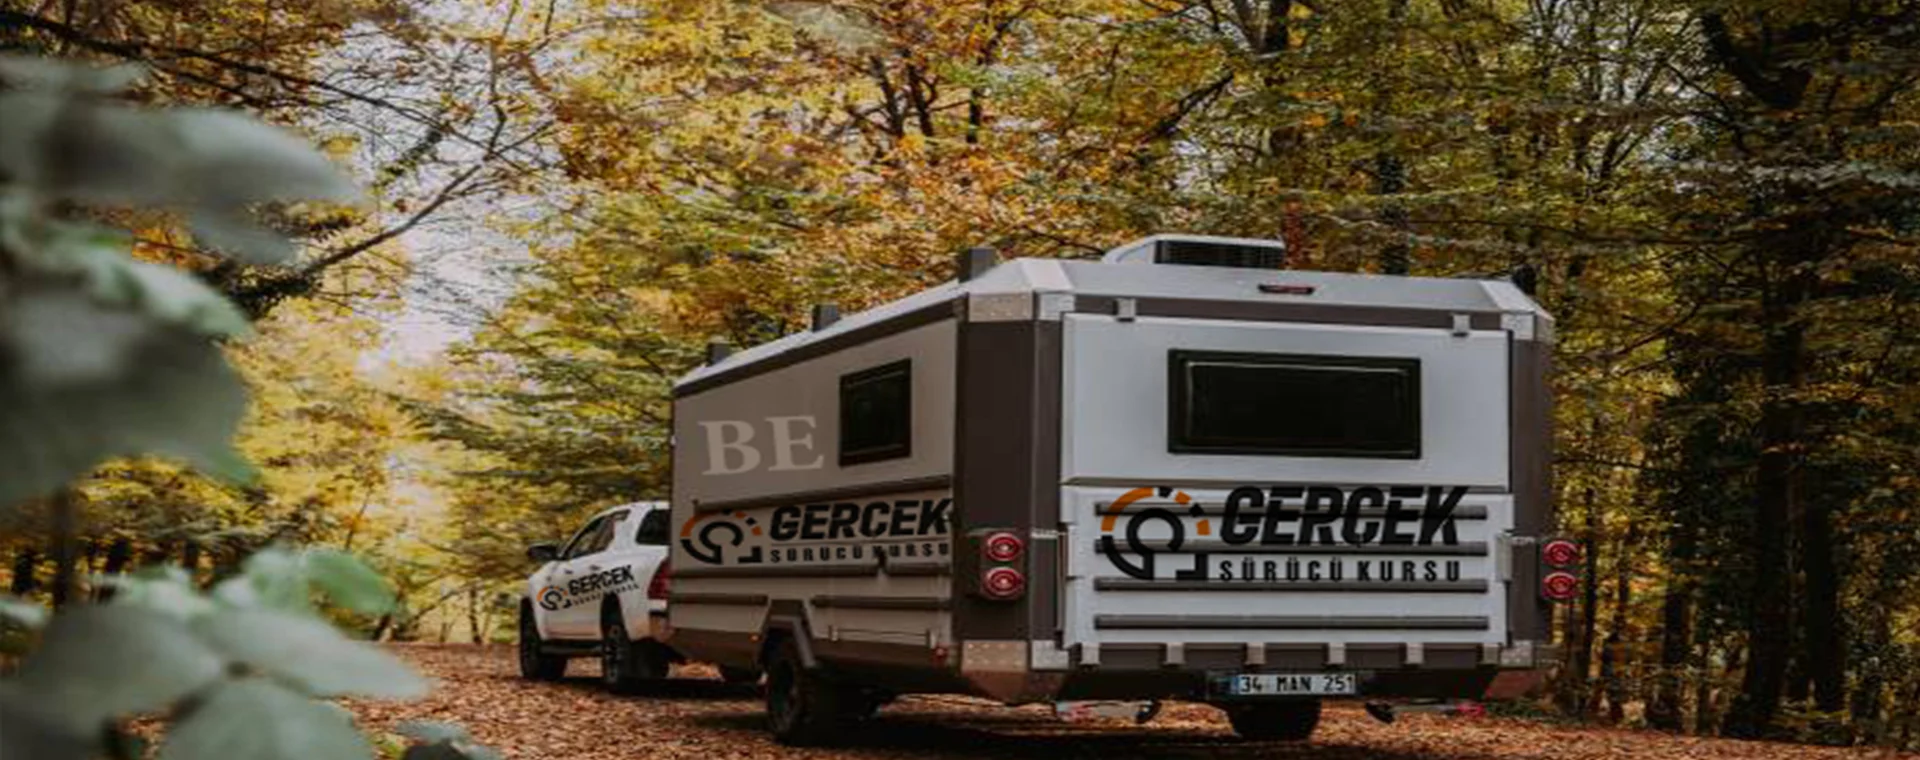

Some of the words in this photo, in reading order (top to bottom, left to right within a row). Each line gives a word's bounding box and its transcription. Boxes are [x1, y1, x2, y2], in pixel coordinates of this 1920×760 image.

[697, 415, 825, 475] BE
[1357, 560, 1460, 582] KURSU
[1240, 676, 1262, 692] 34
[1276, 676, 1312, 692] MAN
